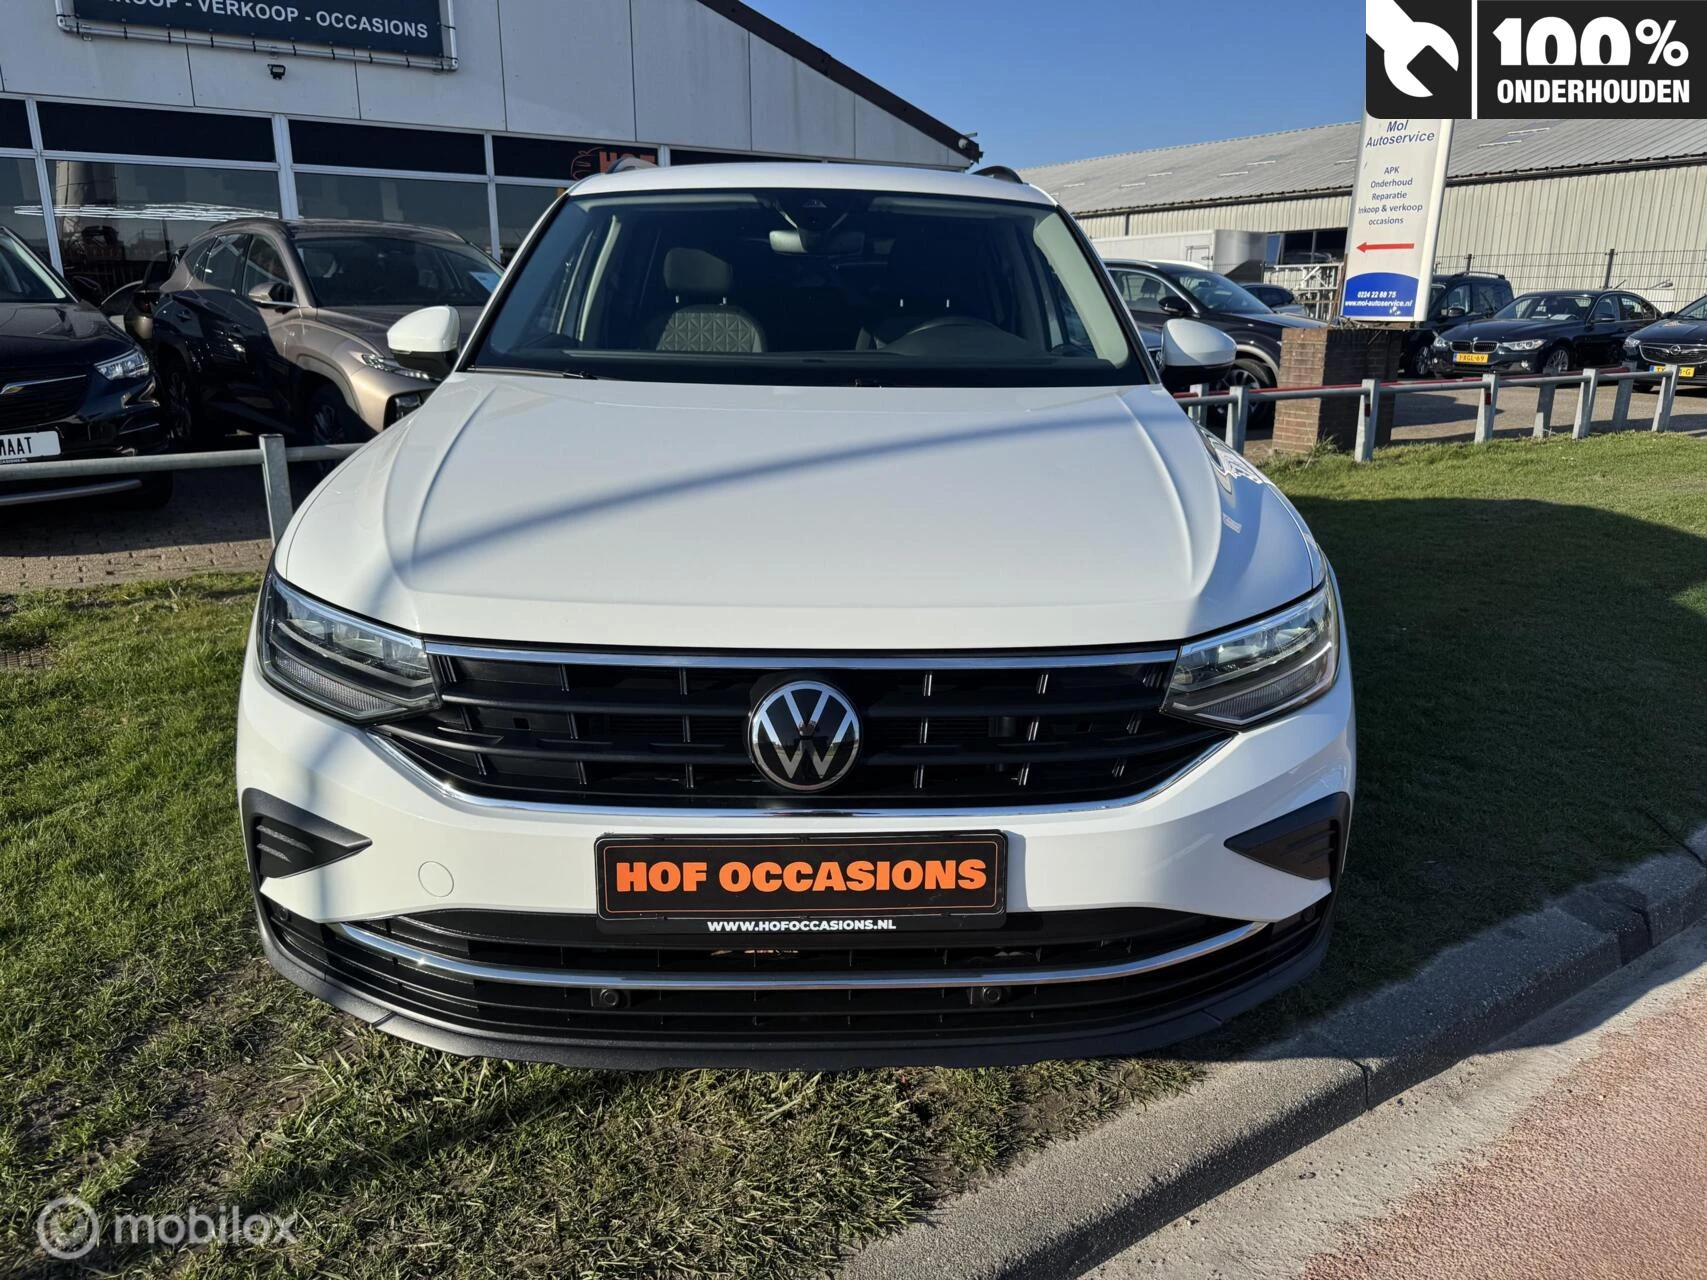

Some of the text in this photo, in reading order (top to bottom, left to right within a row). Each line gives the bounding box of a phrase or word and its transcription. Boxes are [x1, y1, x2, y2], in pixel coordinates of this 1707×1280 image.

[199, 0, 299, 23] VERKOOP
[316, 11, 429, 39] OCCASIONS
[1386, 120, 1408, 133] Mol
[1365, 131, 1435, 148] Autoservice
[1384, 166, 1400, 175] APK
[1370, 178, 1413, 188] Onderhoud
[1371, 191, 1408, 201] Reparatie
[1358, 206, 1380, 214] Inkoop
[1389, 203, 1423, 213] verkoop
[1368, 217, 1404, 226] occasions
[616, 858, 987, 893] HOF OCCASIONS
[707, 919, 897, 933] WWW.HOFOCCASIONS.NL
